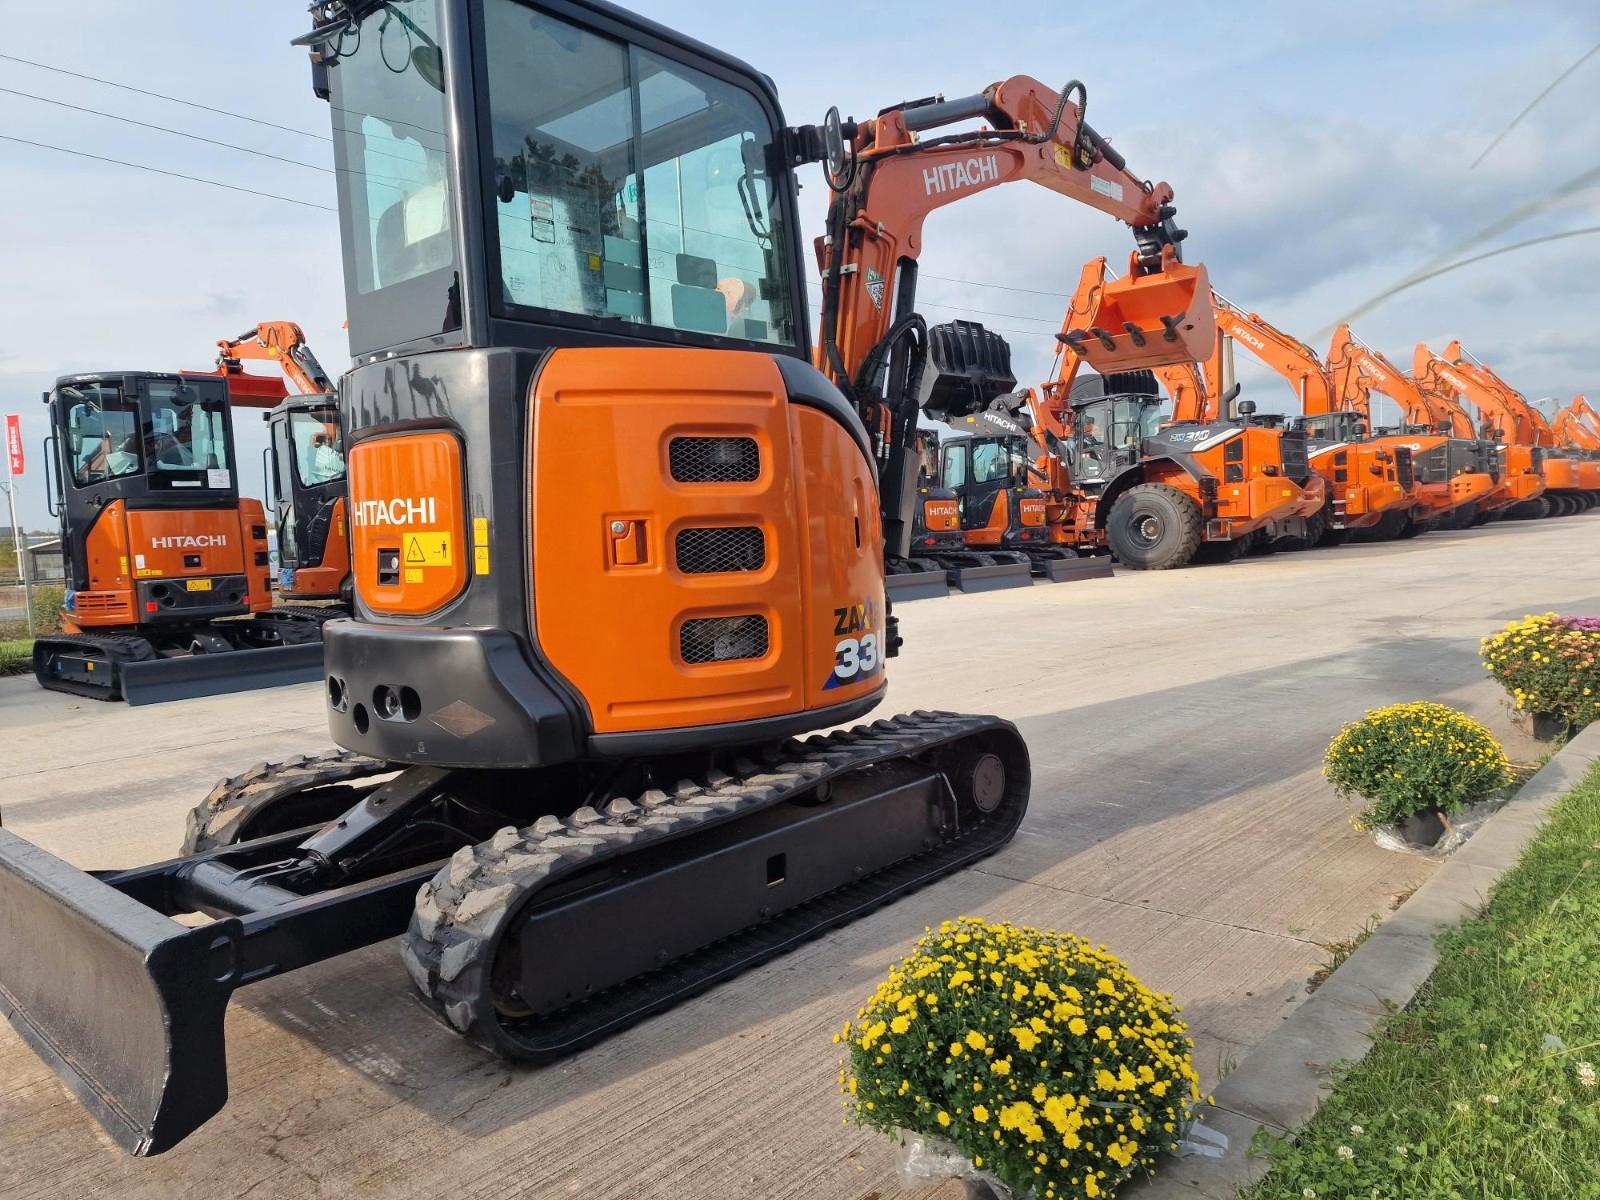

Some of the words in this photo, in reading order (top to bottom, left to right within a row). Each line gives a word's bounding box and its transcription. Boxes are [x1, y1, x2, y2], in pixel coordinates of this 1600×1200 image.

[922, 154, 998, 195] HITACHI
[984, 412, 1016, 431] HITACHI
[354, 497, 437, 526] HITACHI
[151, 535, 227, 549] HITACHI
